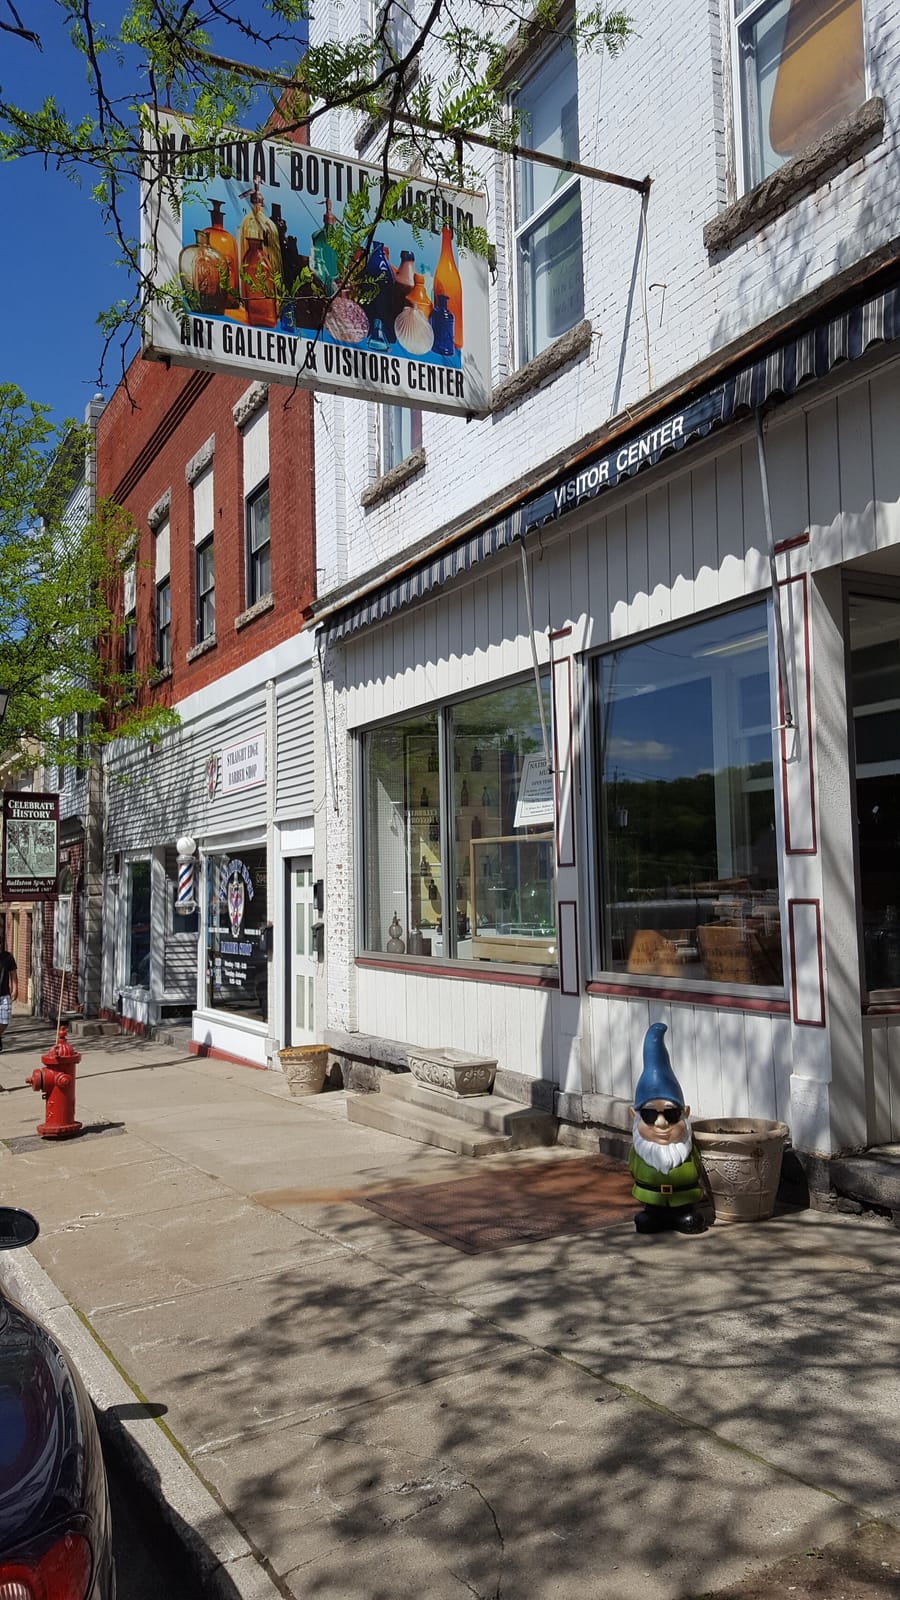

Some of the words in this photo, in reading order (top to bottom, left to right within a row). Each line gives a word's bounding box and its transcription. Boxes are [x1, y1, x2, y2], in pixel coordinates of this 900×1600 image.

[161, 133, 281, 187] NAIONAL
[181, 318, 214, 351] ART
[222, 323, 299, 366] GALLERY
[306, 341, 318, 371] &
[324, 344, 401, 386] VISITORS
[407, 360, 465, 399] CENTER
[554, 461, 609, 508] VISITOR
[616, 416, 684, 470] CENTER
[8, 800, 55, 811] CELEBRATE
[12, 808, 51, 819] HISTORY
